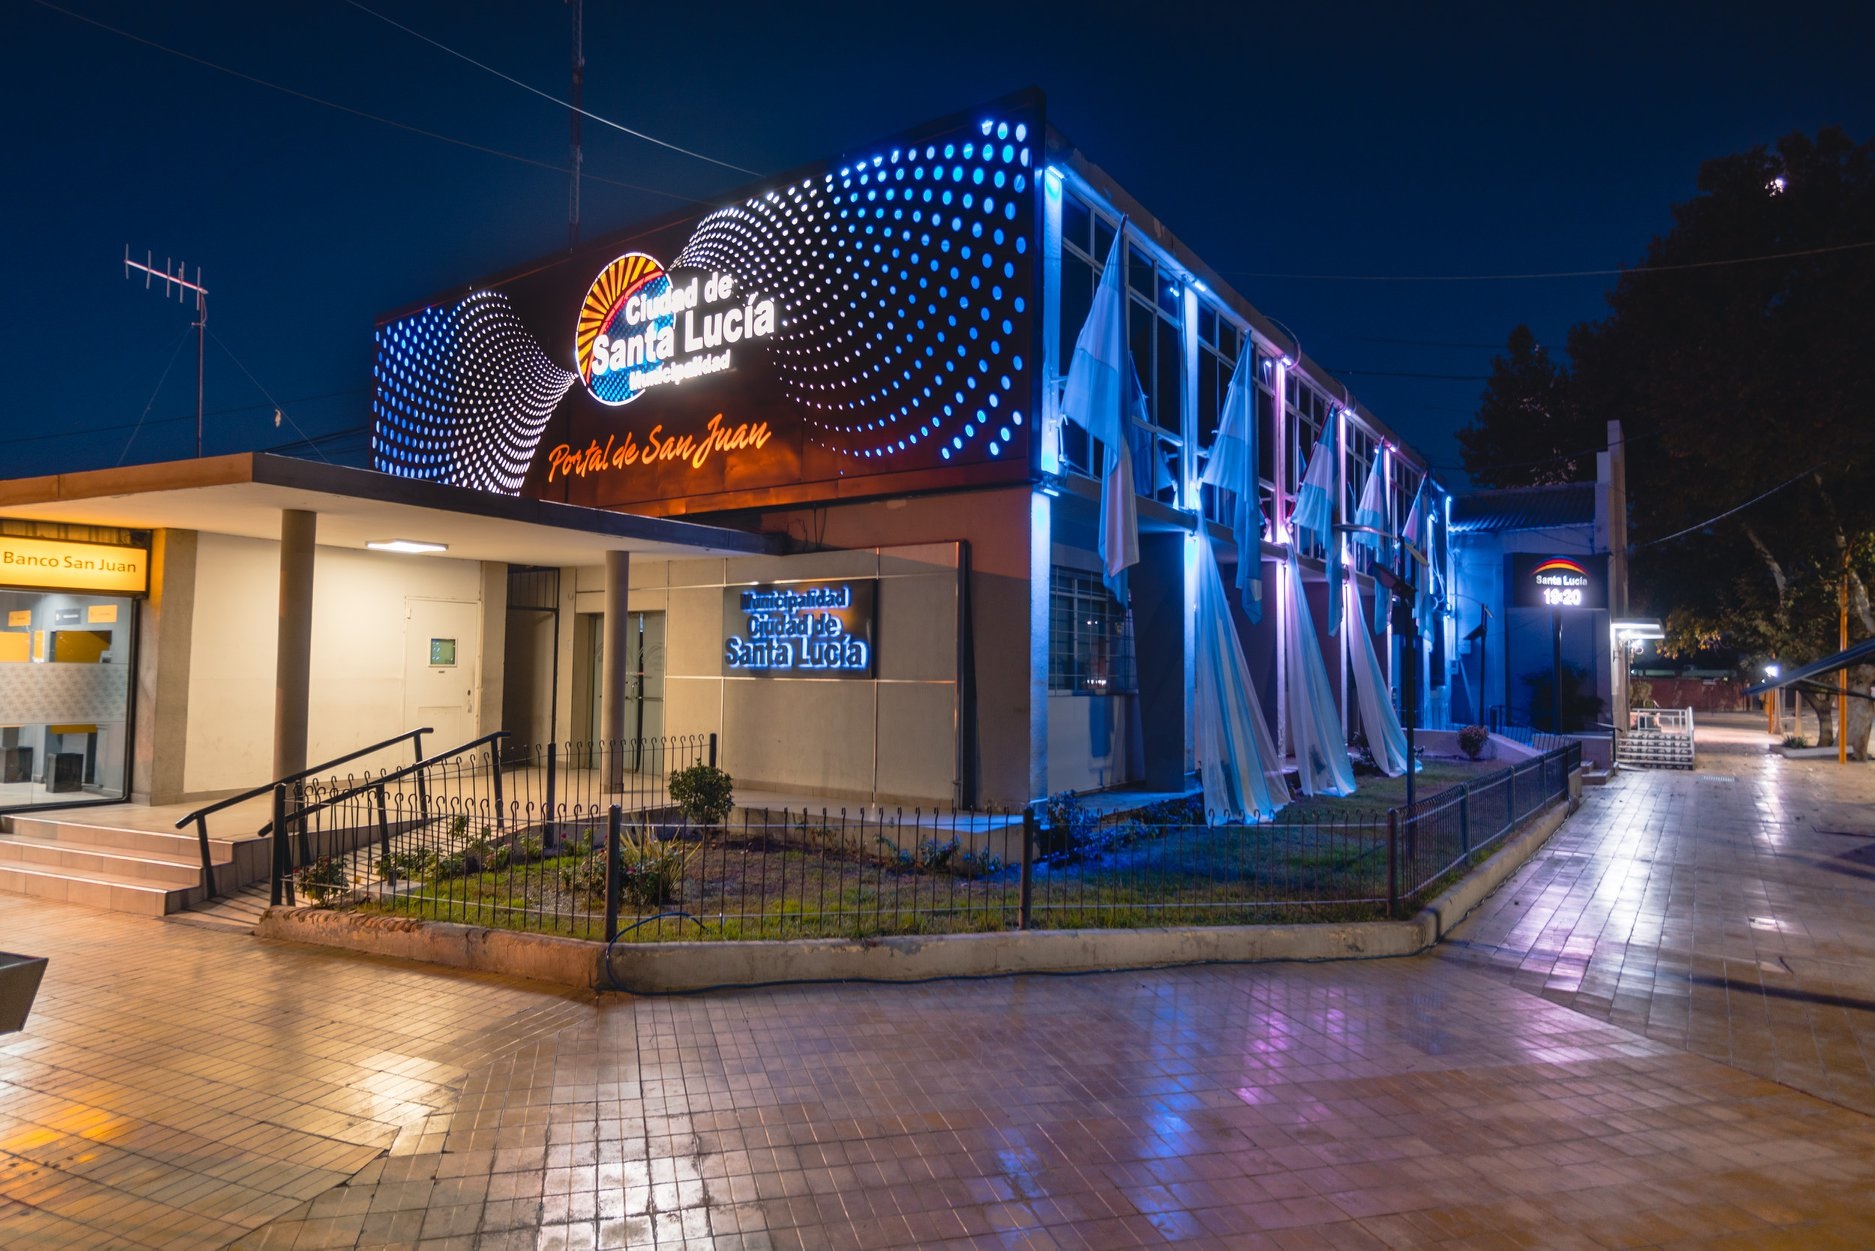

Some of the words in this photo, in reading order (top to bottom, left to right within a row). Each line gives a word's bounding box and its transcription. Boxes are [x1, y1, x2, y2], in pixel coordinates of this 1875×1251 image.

[625, 276, 698, 326] Ciudad
[704, 271, 732, 303] de
[591, 321, 675, 376] Santa
[684, 294, 775, 353] Lucía
[629, 349, 731, 391] Municipalidad
[549, 434, 614, 483] Portal
[612, 432, 639, 469] de
[641, 424, 697, 462] San
[692, 412, 772, 469] Juan
[3, 551, 59, 568] Banco
[63, 555, 95, 571] San
[98, 559, 137, 573] Juan
[1536, 575, 1562, 586] Santa
[740, 586, 851, 614] Municipalidad
[747, 612, 815, 639] Ciudad
[815, 612, 843, 639] de
[725, 635, 796, 670] Santa
[798, 634, 871, 670] Lucía
